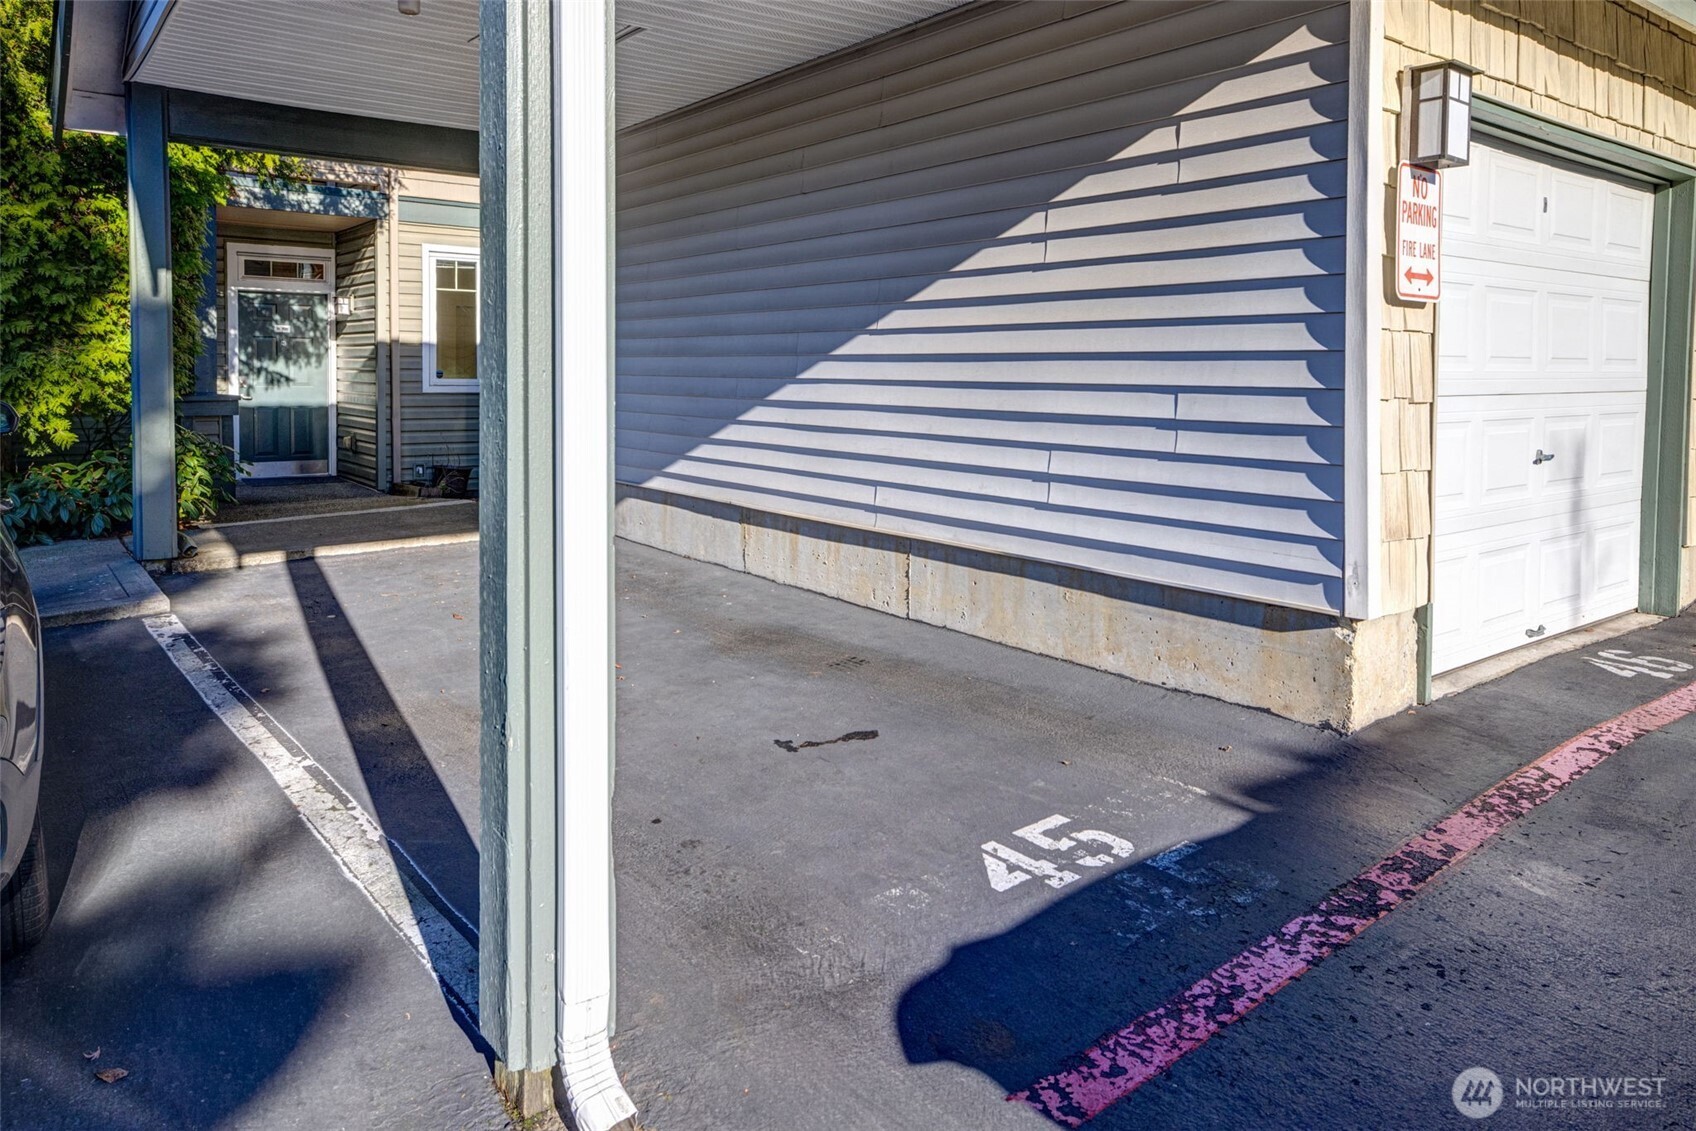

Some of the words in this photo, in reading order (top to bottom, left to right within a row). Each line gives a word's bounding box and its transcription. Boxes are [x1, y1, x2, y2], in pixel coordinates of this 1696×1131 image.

[1413, 174, 1428, 199] NO
[1402, 201, 1437, 228] PARKING
[1402, 240, 1417, 258] FIRE
[1420, 243, 1436, 260] LANE
[1581, 649, 1694, 679] 46
[981, 814, 1135, 892] 45
